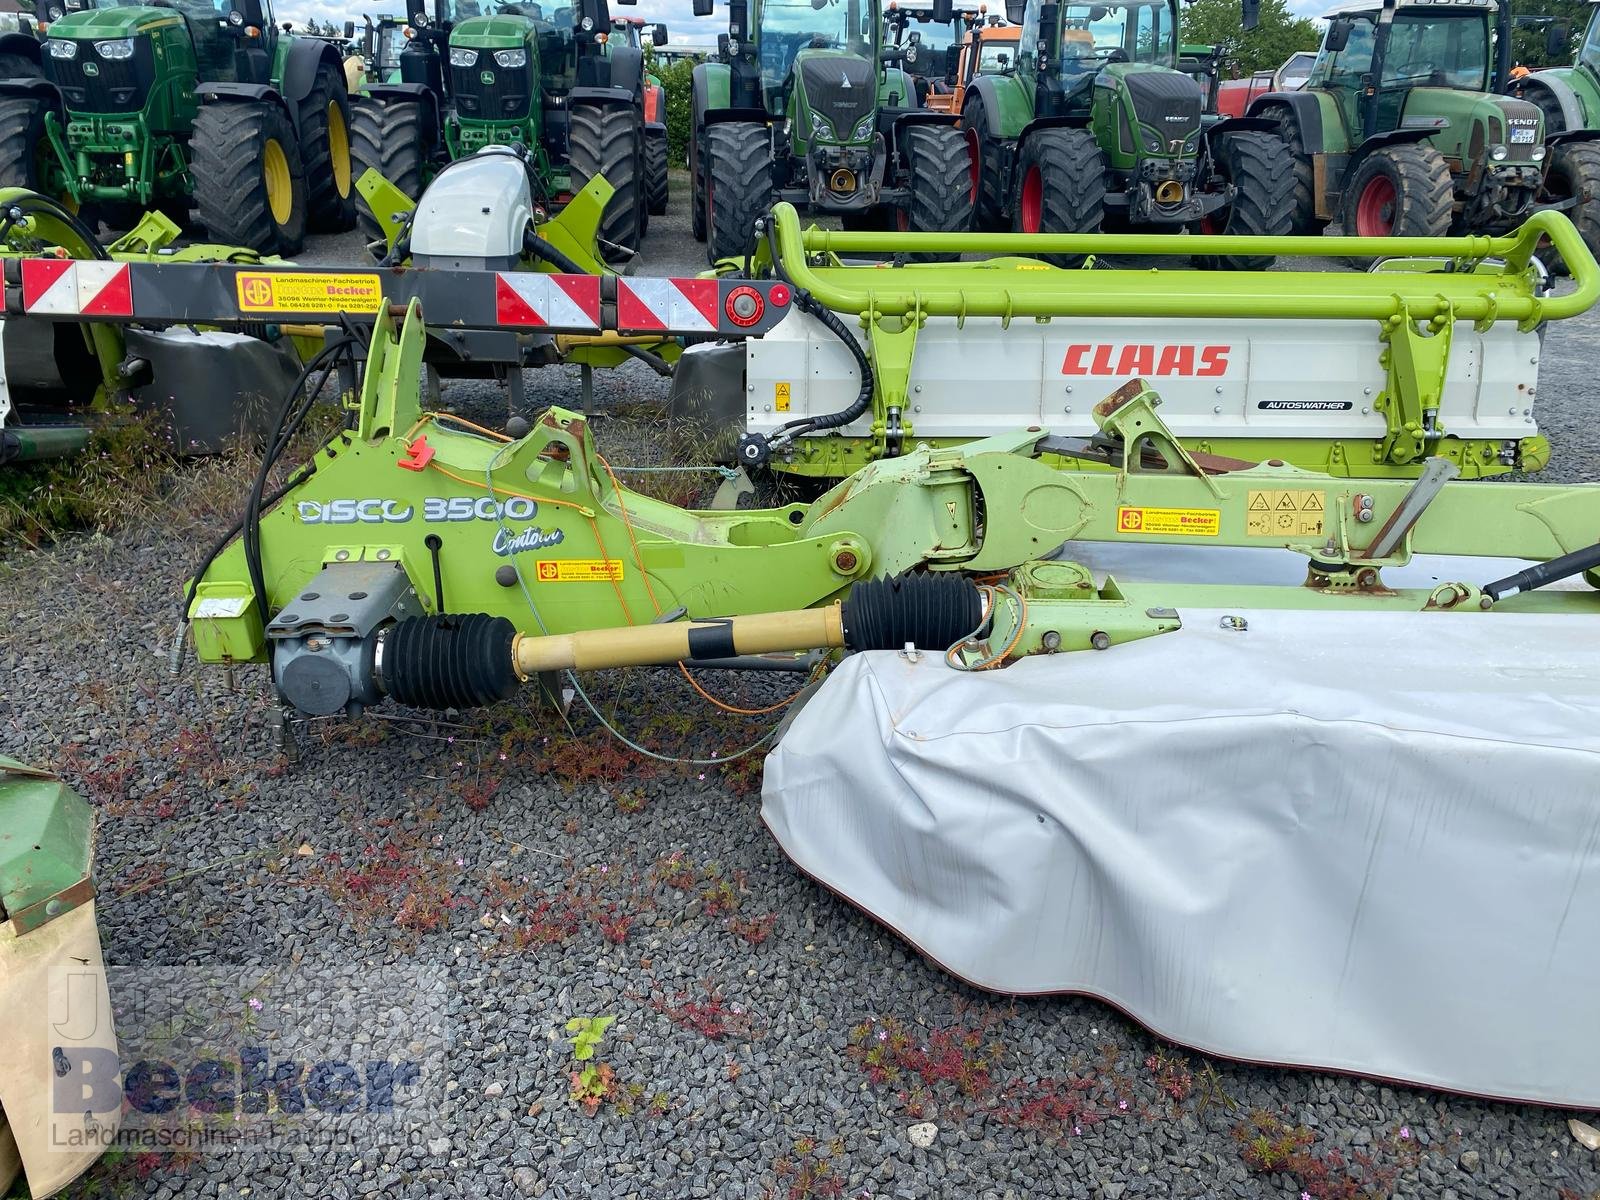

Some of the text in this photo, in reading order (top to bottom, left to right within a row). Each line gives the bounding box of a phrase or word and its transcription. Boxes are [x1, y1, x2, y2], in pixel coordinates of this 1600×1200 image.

[275, 277, 376, 285] Landmaschinen-Fachbetrieb
[326, 285, 373, 295] Becker
[1061, 344, 1231, 377] CLAAS
[1265, 401, 1345, 410] AUTOSWATHER
[298, 496, 538, 524] DISCO 3500
[1180, 516, 1214, 524] Becker
